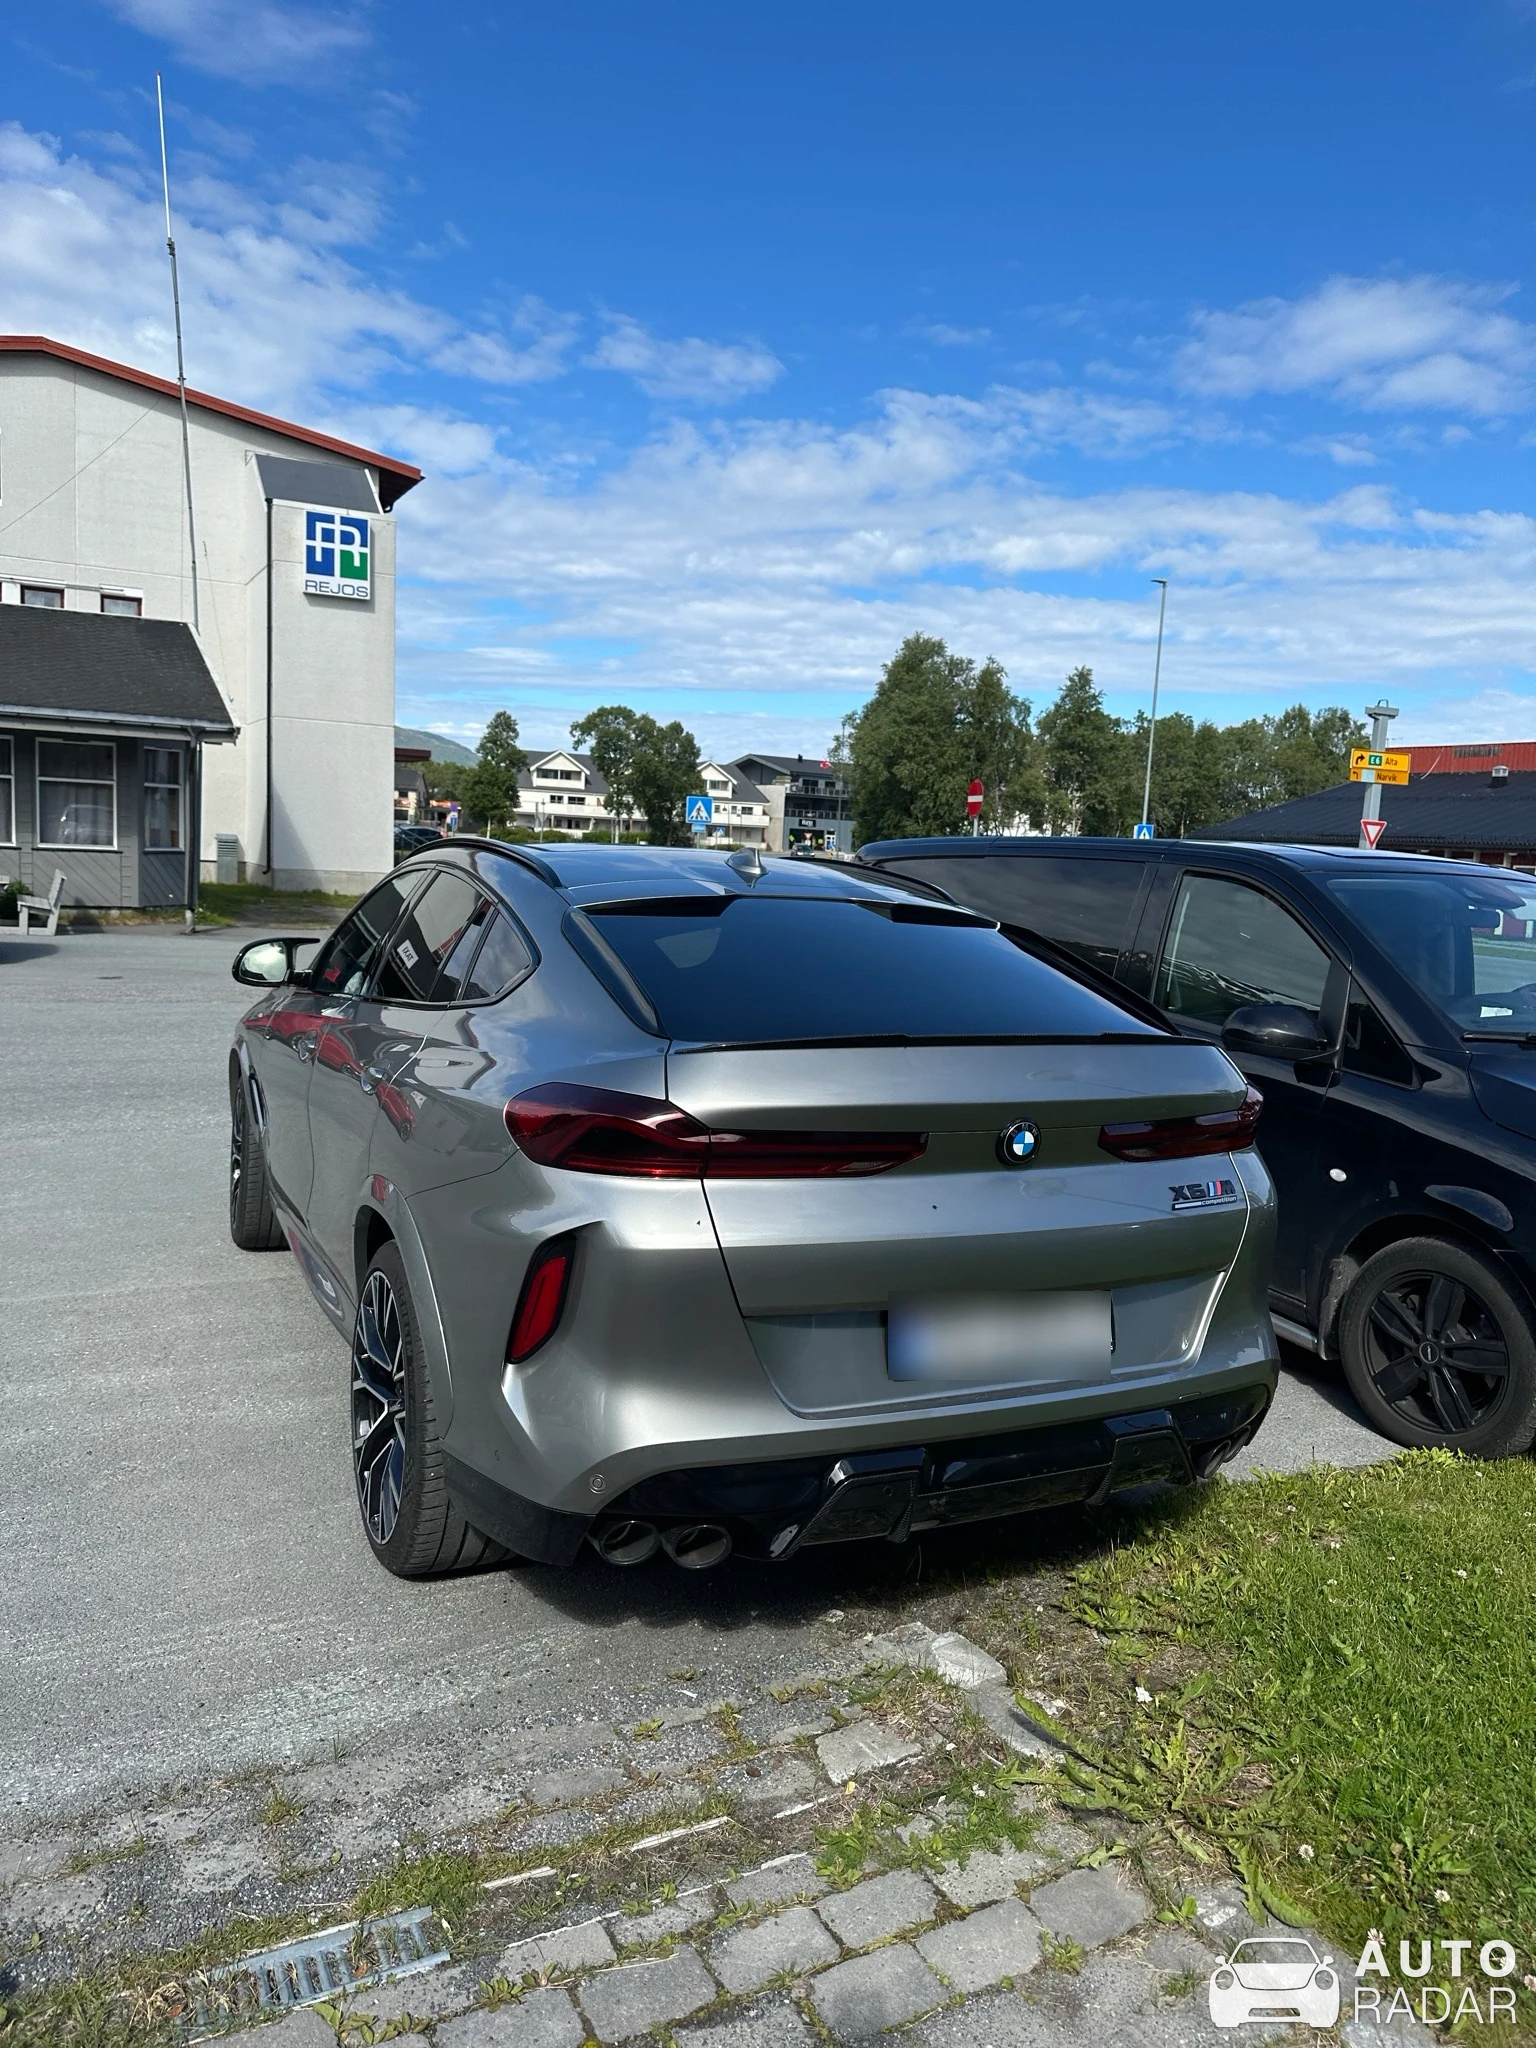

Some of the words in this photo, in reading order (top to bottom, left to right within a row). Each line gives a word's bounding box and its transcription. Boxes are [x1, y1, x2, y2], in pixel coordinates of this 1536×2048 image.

[305, 580, 369, 598] REJOS
[1370, 756, 1381, 765] E6
[1385, 757, 1398, 766] Alta
[1377, 773, 1398, 782] Narvik
[1201, 1196, 1237, 1206] competition
